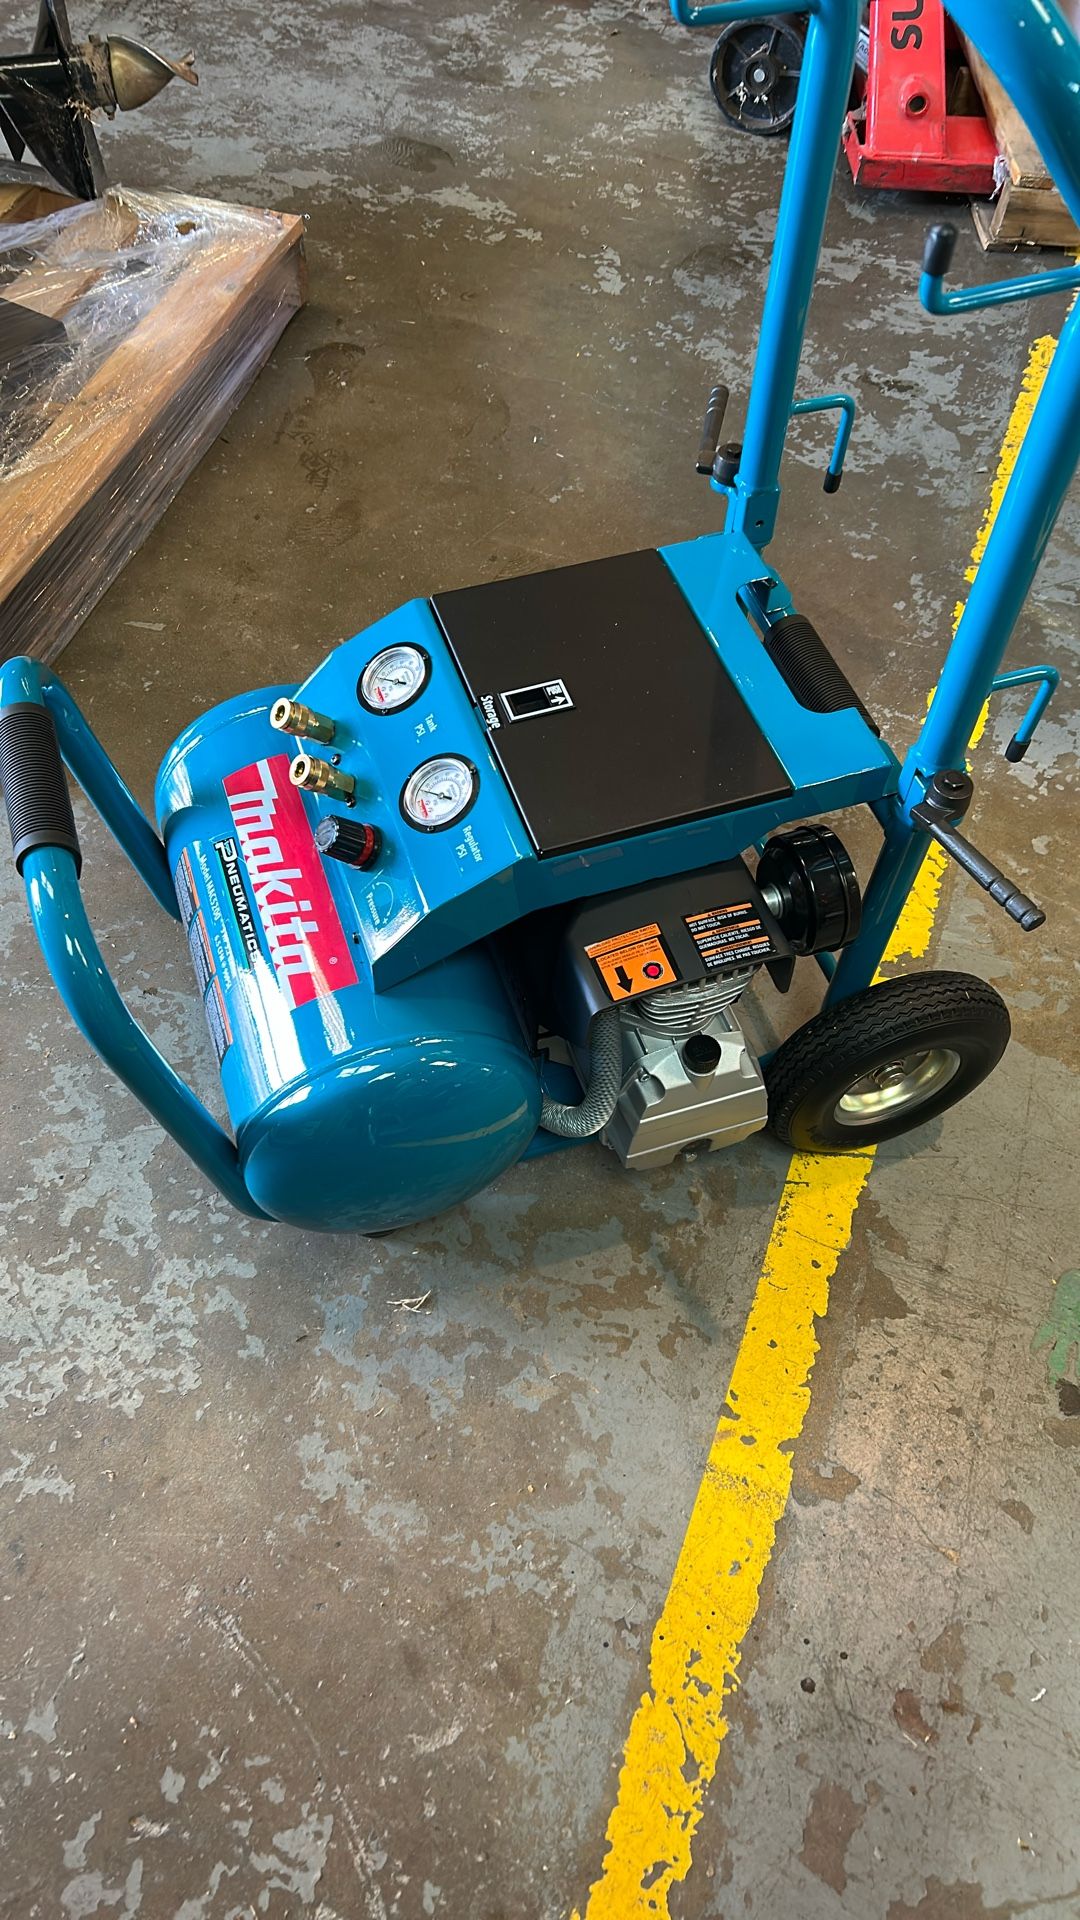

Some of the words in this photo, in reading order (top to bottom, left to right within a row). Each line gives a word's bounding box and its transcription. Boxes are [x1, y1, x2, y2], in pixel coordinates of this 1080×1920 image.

[425, 713, 437, 733] Tank
[481, 695, 501, 729] Storage
[414, 723, 426, 737] PSI
[455, 844, 468, 859] PSI
[462, 824, 483, 863] Regulator
[200, 854, 212, 882] Model
[206, 881, 222, 921] MAC5200
[366, 892, 380, 925] Pressure
